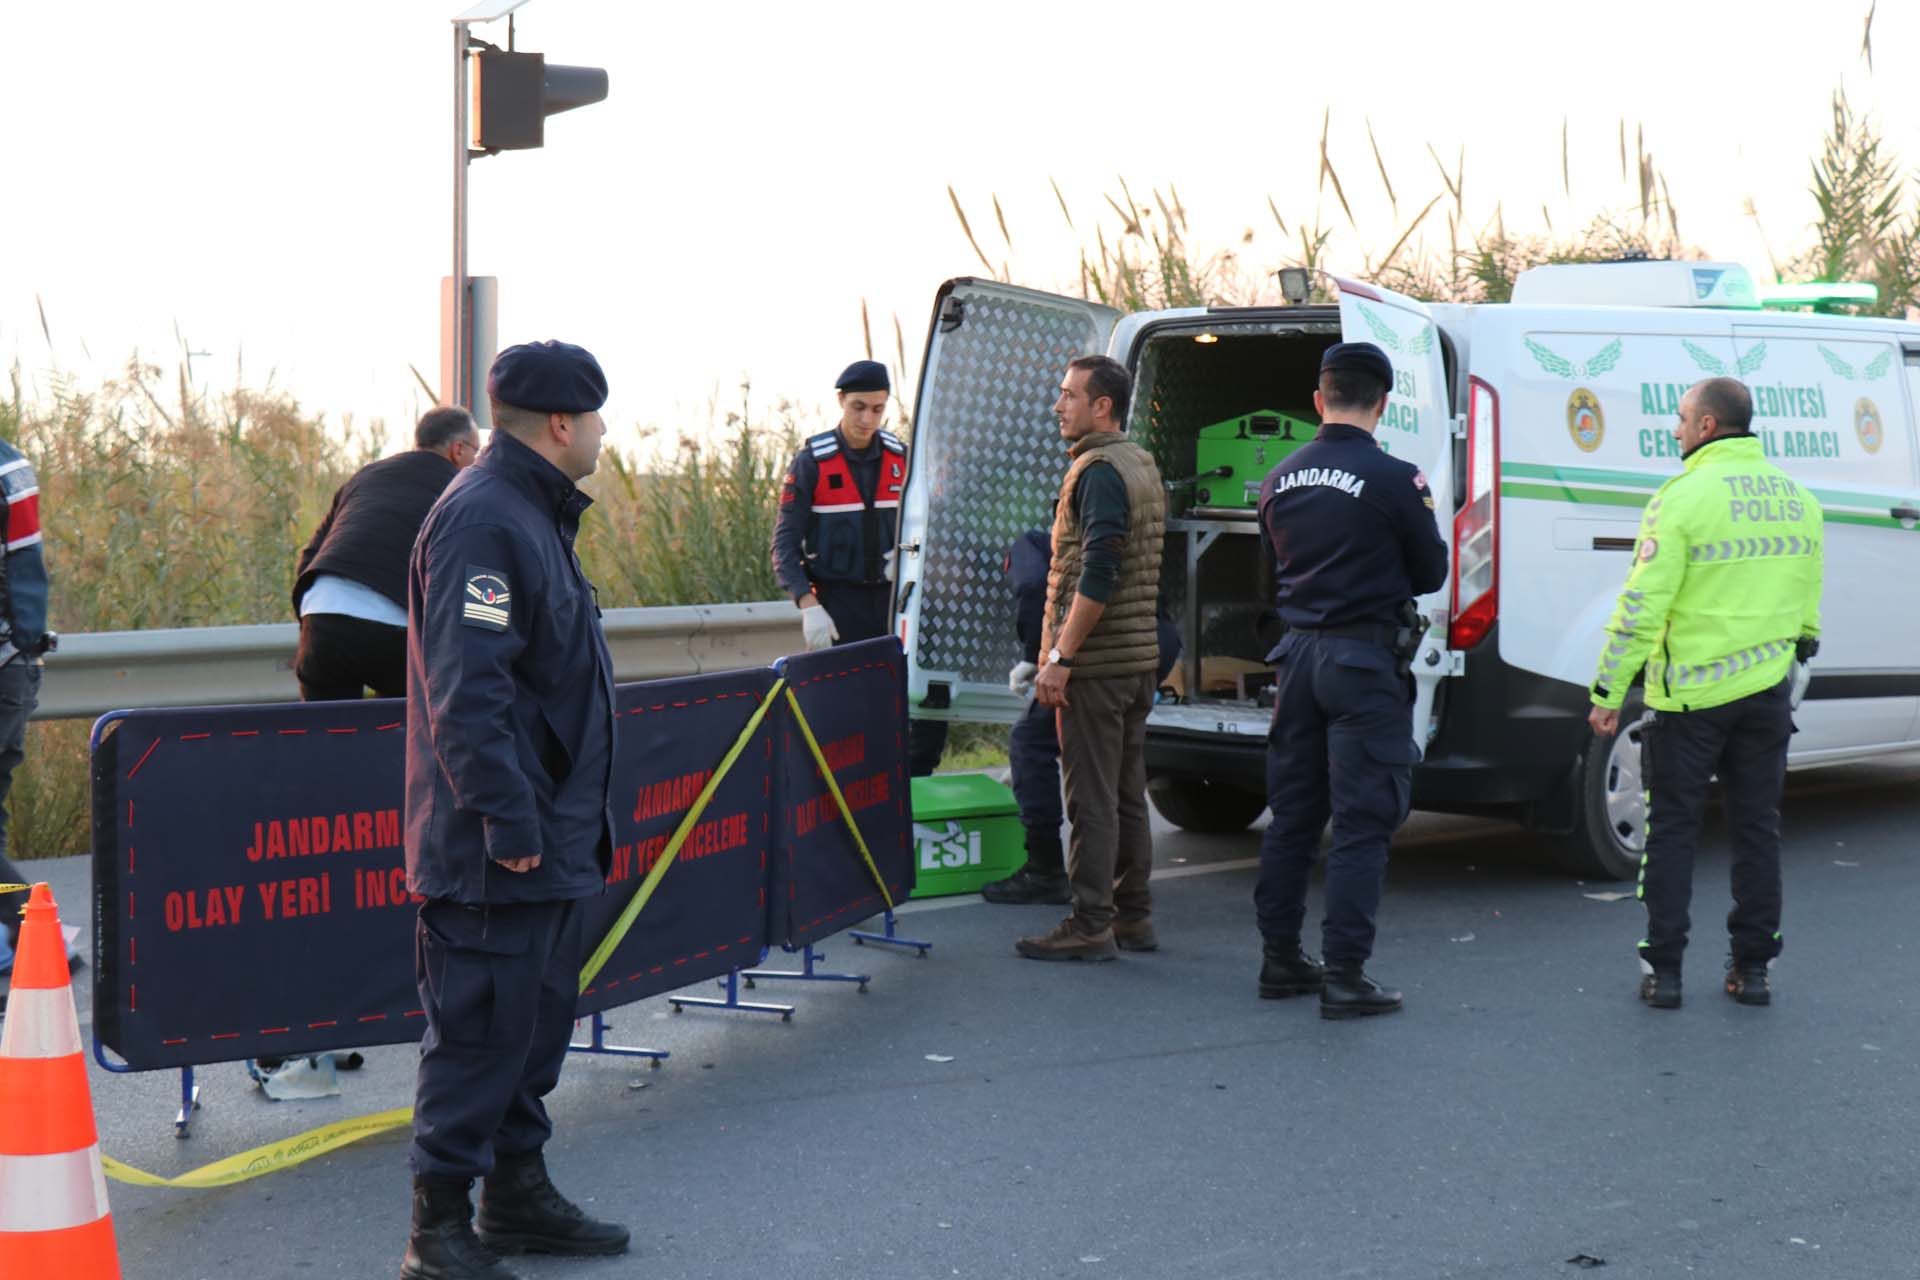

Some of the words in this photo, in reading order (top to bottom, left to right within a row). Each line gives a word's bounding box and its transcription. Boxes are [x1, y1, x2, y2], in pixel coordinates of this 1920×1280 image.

[1395, 369, 1417, 399] ESİ
[1752, 381, 1827, 418] EDİYESİ
[1637, 428, 1682, 458] CEN
[1783, 430, 1840, 458] ARACI
[1275, 467, 1366, 498] JANDARMA
[246, 809, 401, 862] JANDARM
[637, 829, 672, 876] YER
[914, 830, 982, 870] ESİ
[165, 885, 245, 932] OLAY
[258, 872, 331, 920] YERİ
[355, 866, 426, 910] İNC
